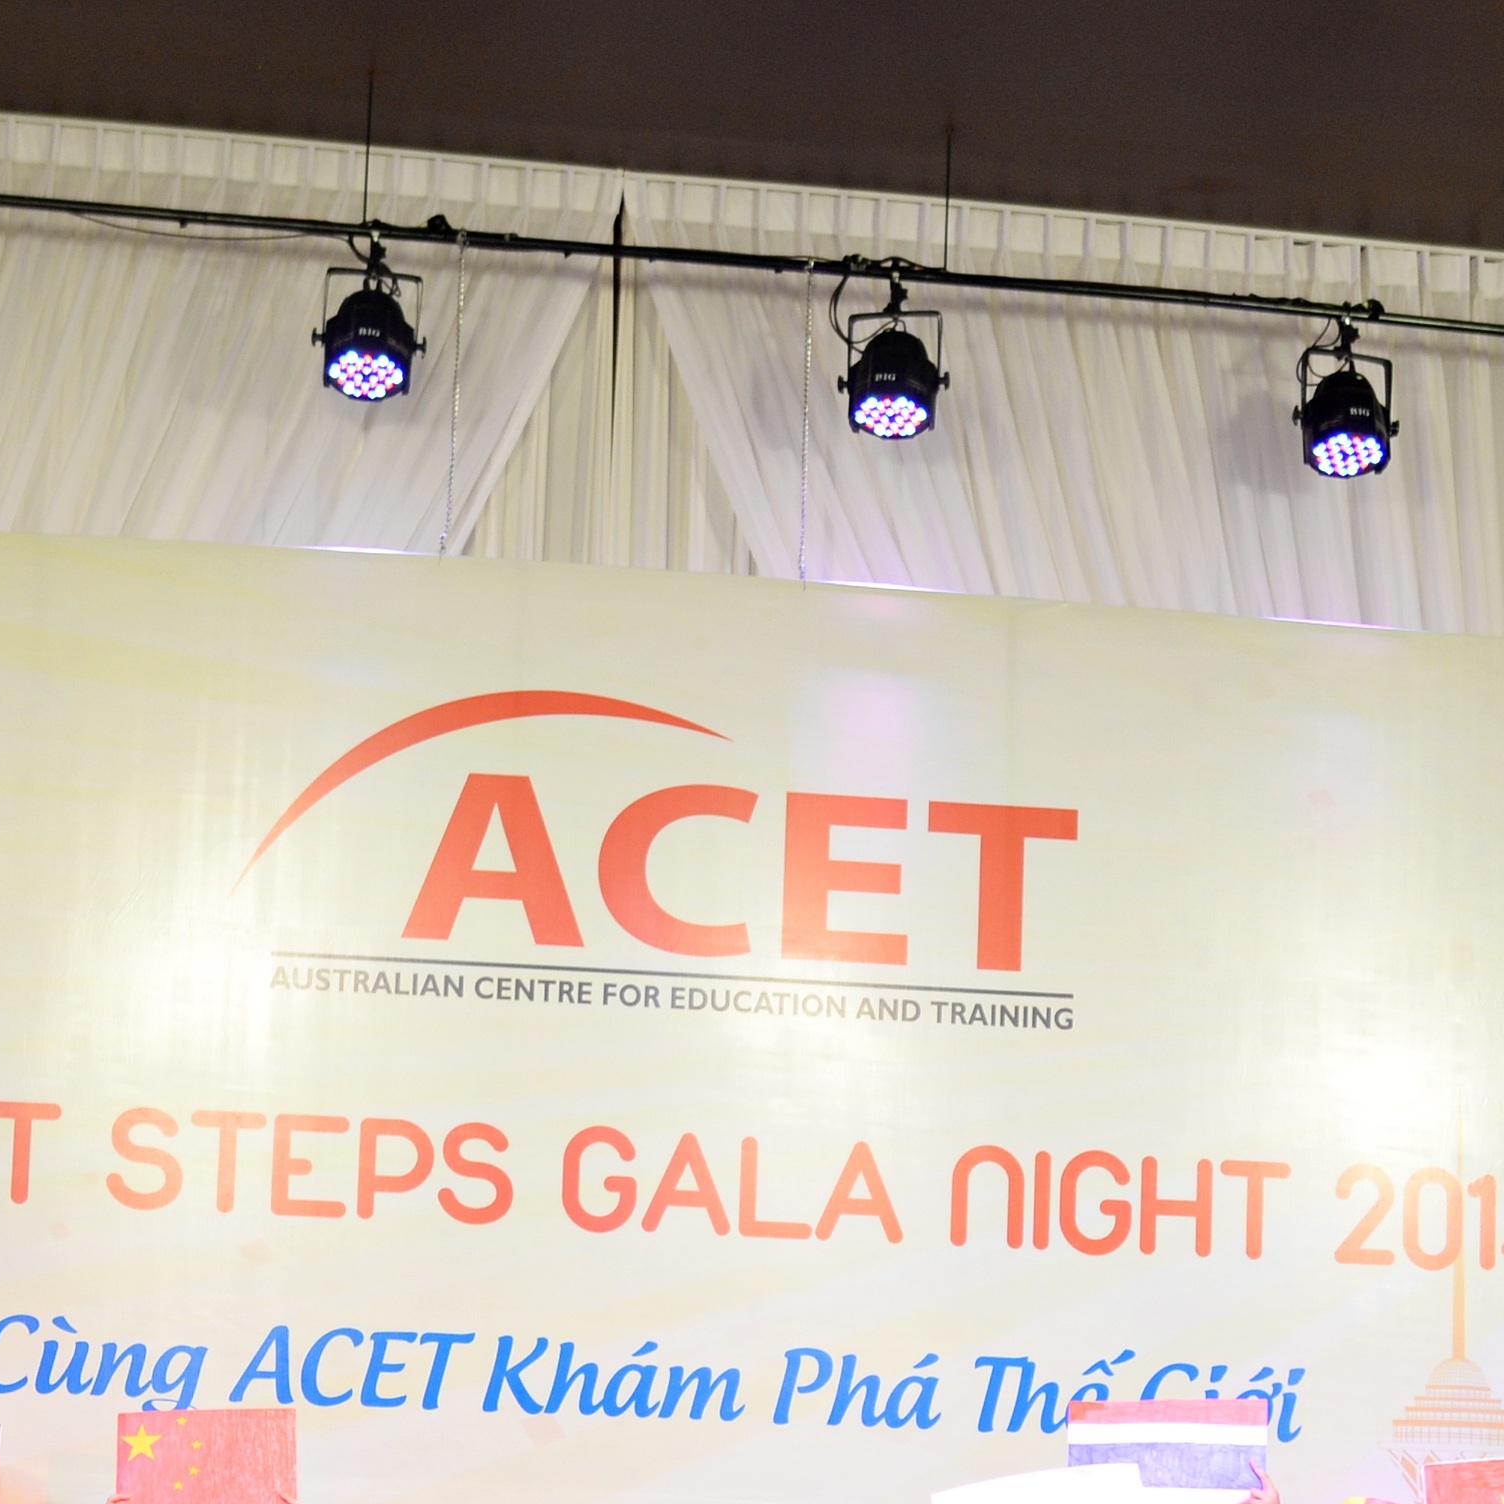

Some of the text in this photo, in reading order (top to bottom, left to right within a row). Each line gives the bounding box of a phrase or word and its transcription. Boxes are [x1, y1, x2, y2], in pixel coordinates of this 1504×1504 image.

[400, 772, 1079, 973] ACET
[269, 965, 1075, 1031] AUSTRALIAN CENTRE FOR EDUCATION AND TRAINING
[104, 1106, 515, 1226] STEPS
[561, 1124, 905, 1244] GALA
[950, 1144, 1292, 1260] NIGHT
[229, 1324, 476, 1410] ACET
[484, 1333, 744, 1423] Khám
[772, 1346, 941, 1433] Phá
